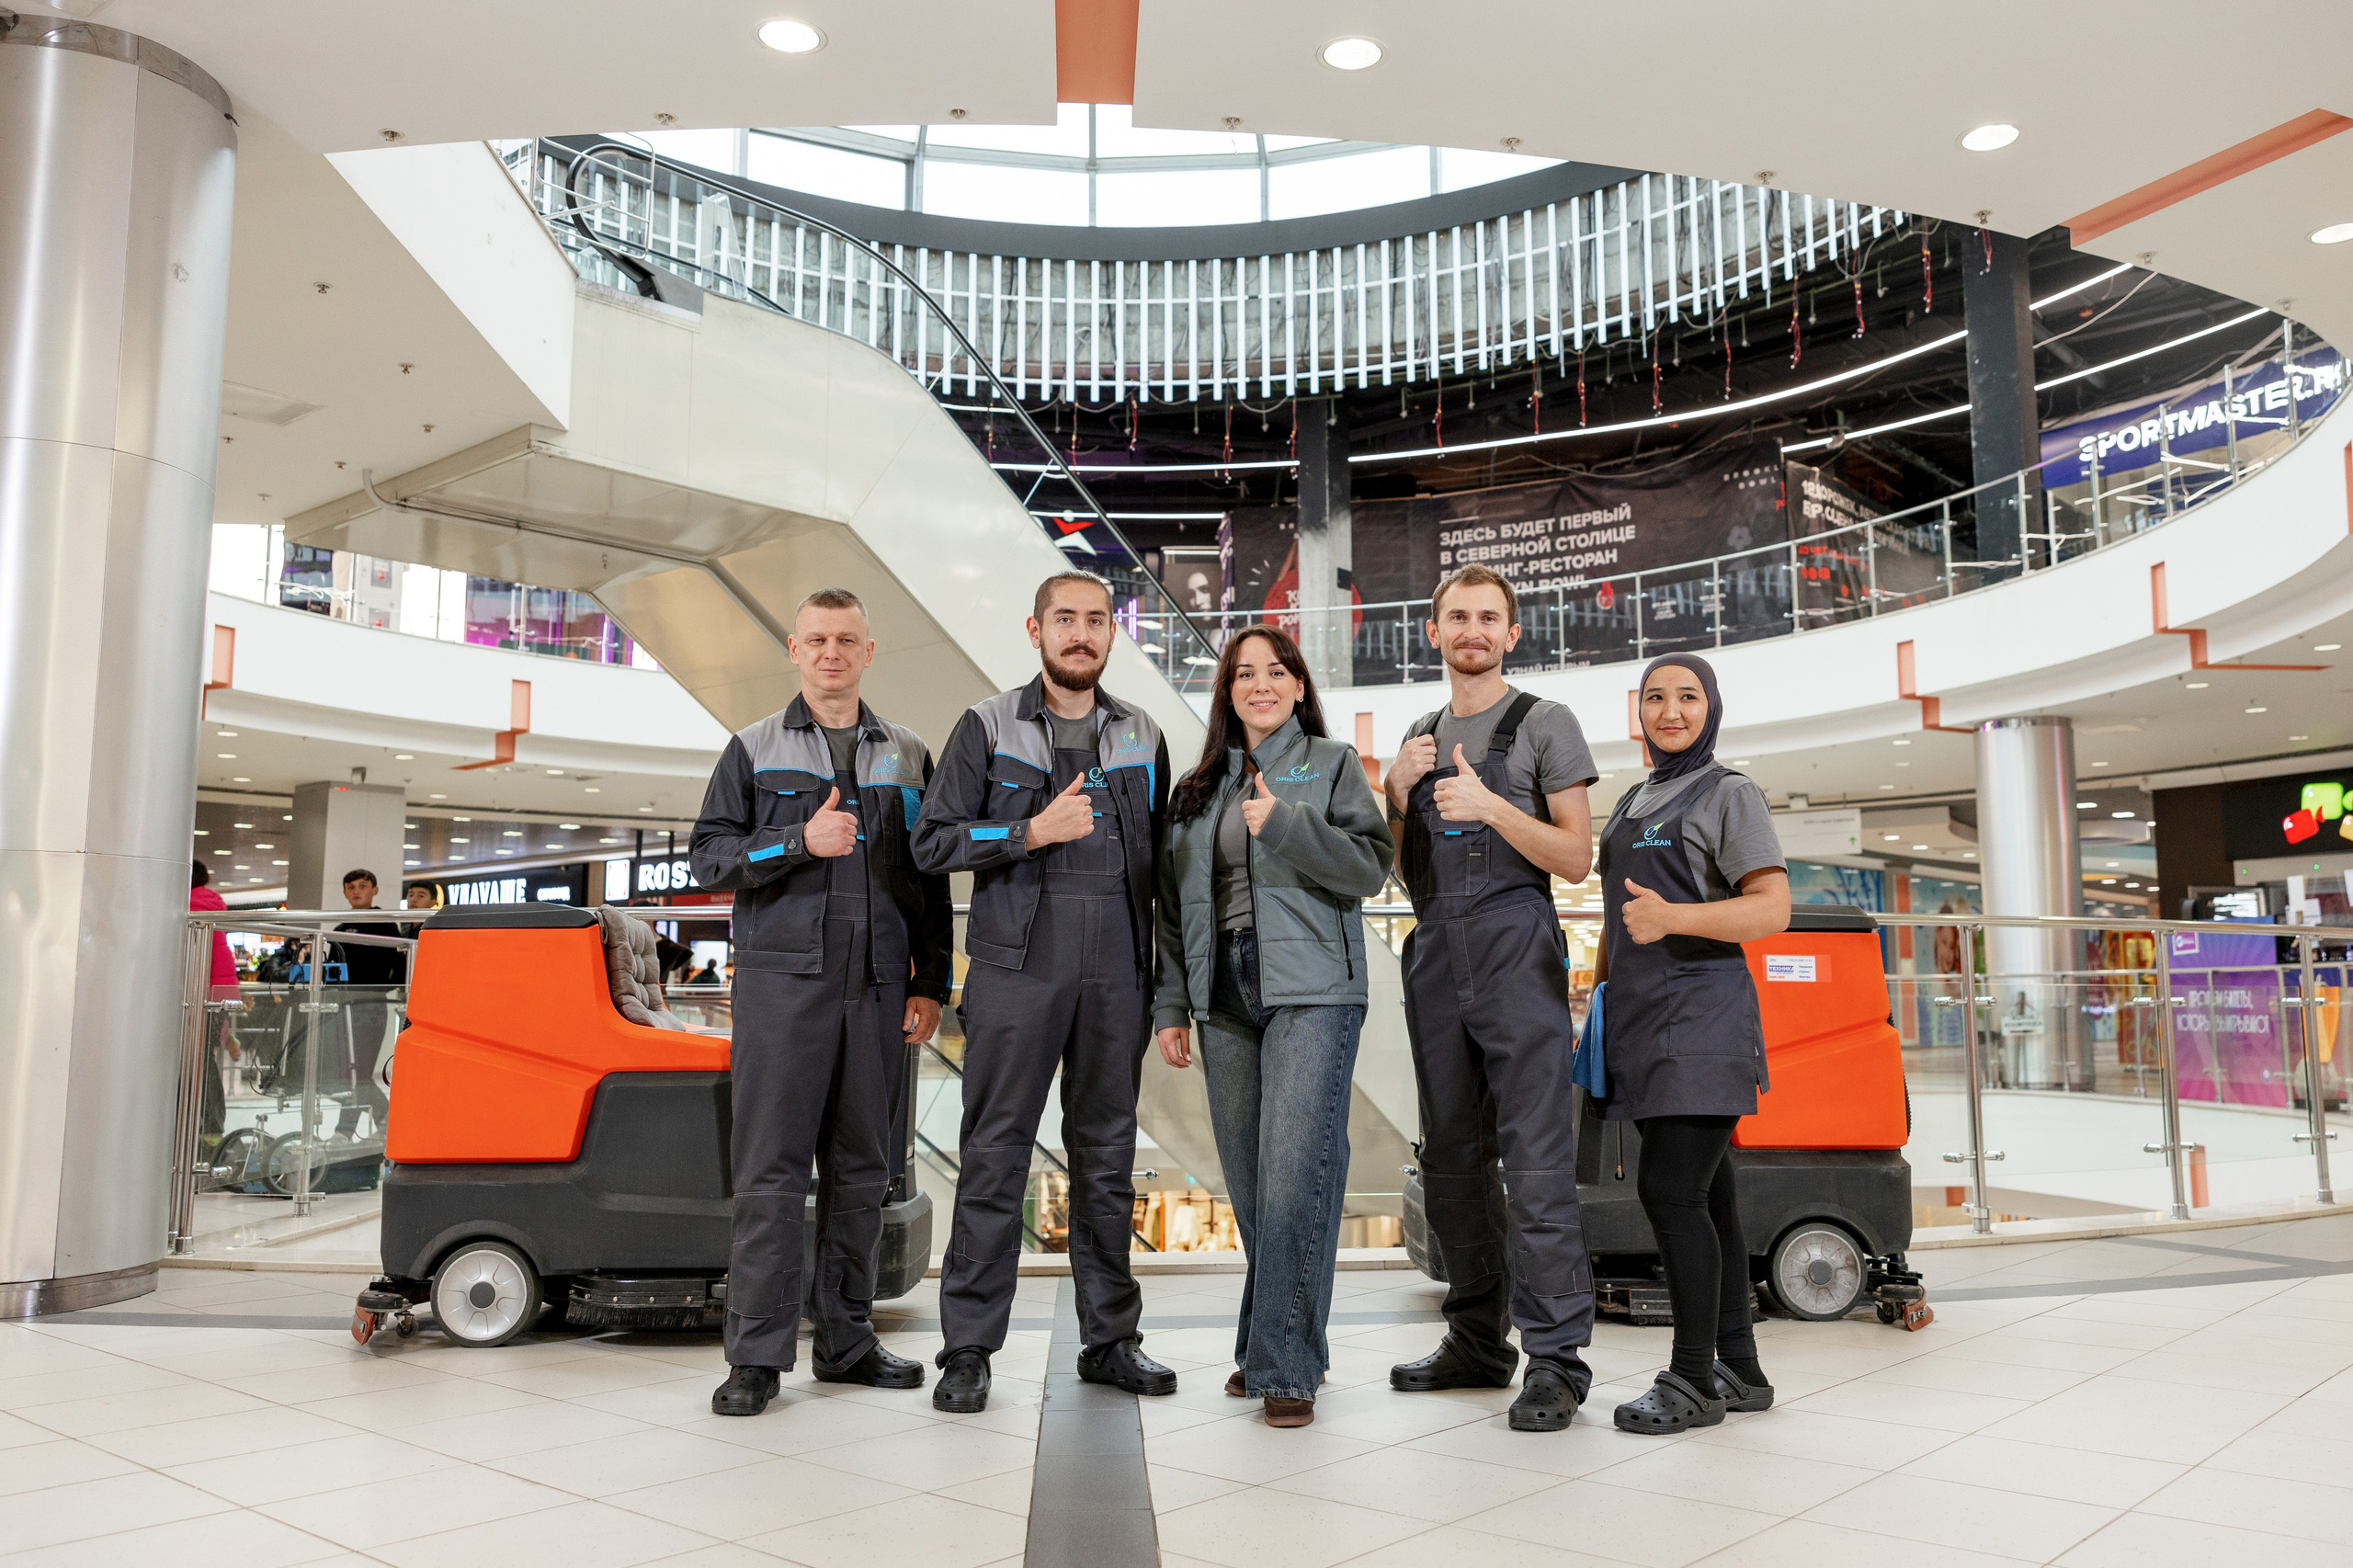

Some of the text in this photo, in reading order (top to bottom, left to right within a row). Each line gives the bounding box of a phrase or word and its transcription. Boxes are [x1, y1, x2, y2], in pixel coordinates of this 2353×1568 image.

[1439, 503, 1631, 547] ЗДЕСЬ БУДЕТ ПЕРВЫЙ
[1440, 525, 1636, 565] В СЕВЕРНОЙ СТОЛИЦЕ
[1294, 772, 1320, 782] CLEAN
[1632, 841, 1645, 849] ORIS
